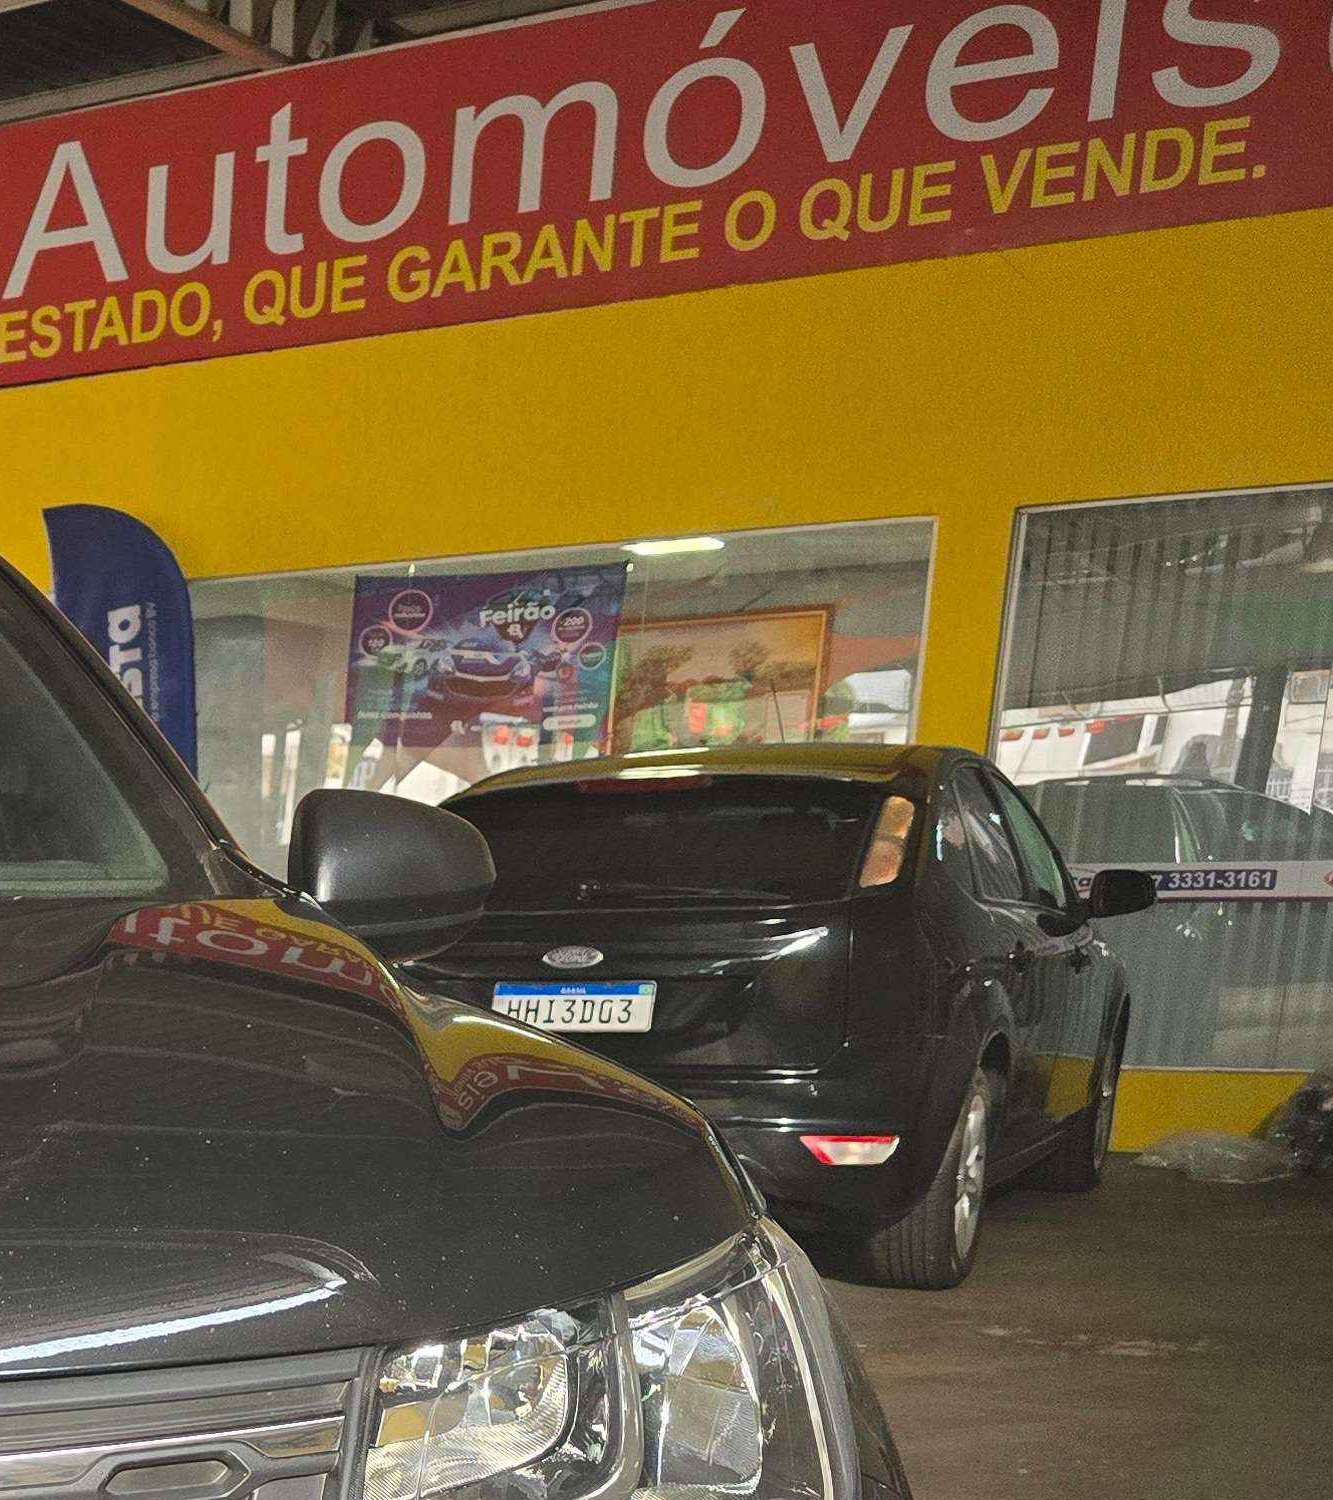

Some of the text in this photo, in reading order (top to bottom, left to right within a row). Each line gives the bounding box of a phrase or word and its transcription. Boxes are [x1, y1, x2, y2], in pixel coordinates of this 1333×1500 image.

[2, 0, 1281, 299] Automóveis
[244, 255, 369, 326] QUE
[387, 200, 702, 303] GARANTE
[724, 191, 776, 252] O
[799, 160, 958, 242] QUE
[980, 116, 1267, 214] VENDE.
[479, 599, 556, 628] Feirão
[1169, 871, 1272, 889] 3331-3161
